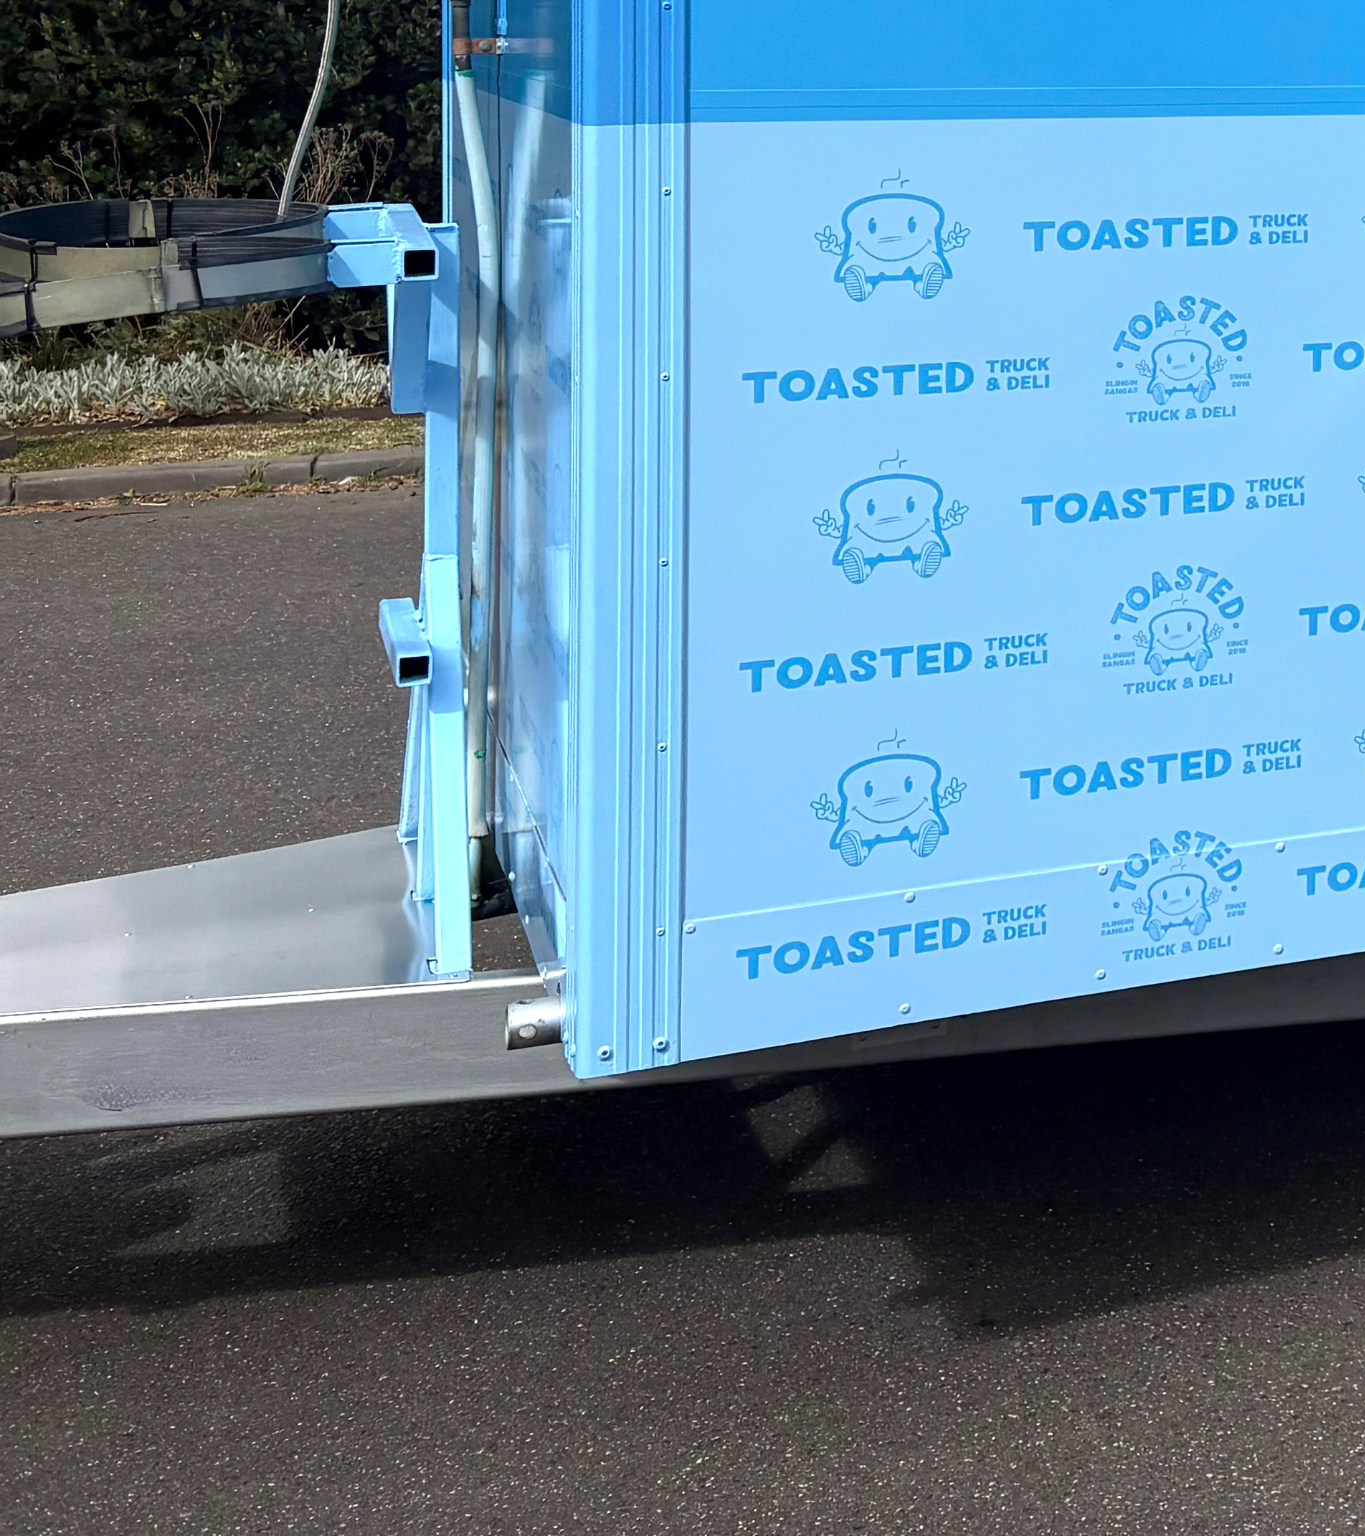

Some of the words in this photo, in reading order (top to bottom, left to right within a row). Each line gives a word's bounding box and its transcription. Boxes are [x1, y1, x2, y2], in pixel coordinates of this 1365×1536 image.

[1249, 214, 1308, 228] TRUCK
[1023, 216, 1238, 252] TOASTED
[1249, 232, 1262, 245] &
[1269, 230, 1308, 244] DELI
[1113, 296, 1247, 352] TOASTED
[986, 357, 1050, 373] TRUCK
[742, 362, 974, 403] TOASTED
[986, 377, 1000, 391] &
[1007, 374, 1049, 390] DELI
[1126, 409, 1180, 423] TRUCK
[1202, 405, 1236, 419] DELI
[1245, 476, 1304, 492] TRUCK
[1021, 482, 1235, 526] TOASTED
[1246, 496, 1259, 510] &
[1266, 492, 1305, 508] DELI
[1110, 565, 1244, 625] TOASTED
[984, 633, 1048, 651] TRUCK
[739, 641, 972, 693] TOASTED
[984, 655, 998, 669] &
[1005, 650, 1047, 667] DELI
[1123, 679, 1177, 695] TRUCK
[1199, 673, 1233, 687] DELI
[1242, 738, 1301, 757] TRUCK
[1020, 748, 1232, 799] TOASTED
[1243, 761, 1256, 774] &
[1262, 755, 1301, 772] DELI
[1109, 830, 1242, 893] TOASTED
[982, 904, 1046, 925] TRUCK
[983, 929, 997, 943] &
[1004, 921, 1046, 940] DELI
[736, 916, 970, 980] TOASTED
[1122, 943, 1176, 962] TRUCK
[1197, 935, 1231, 951] DELI
